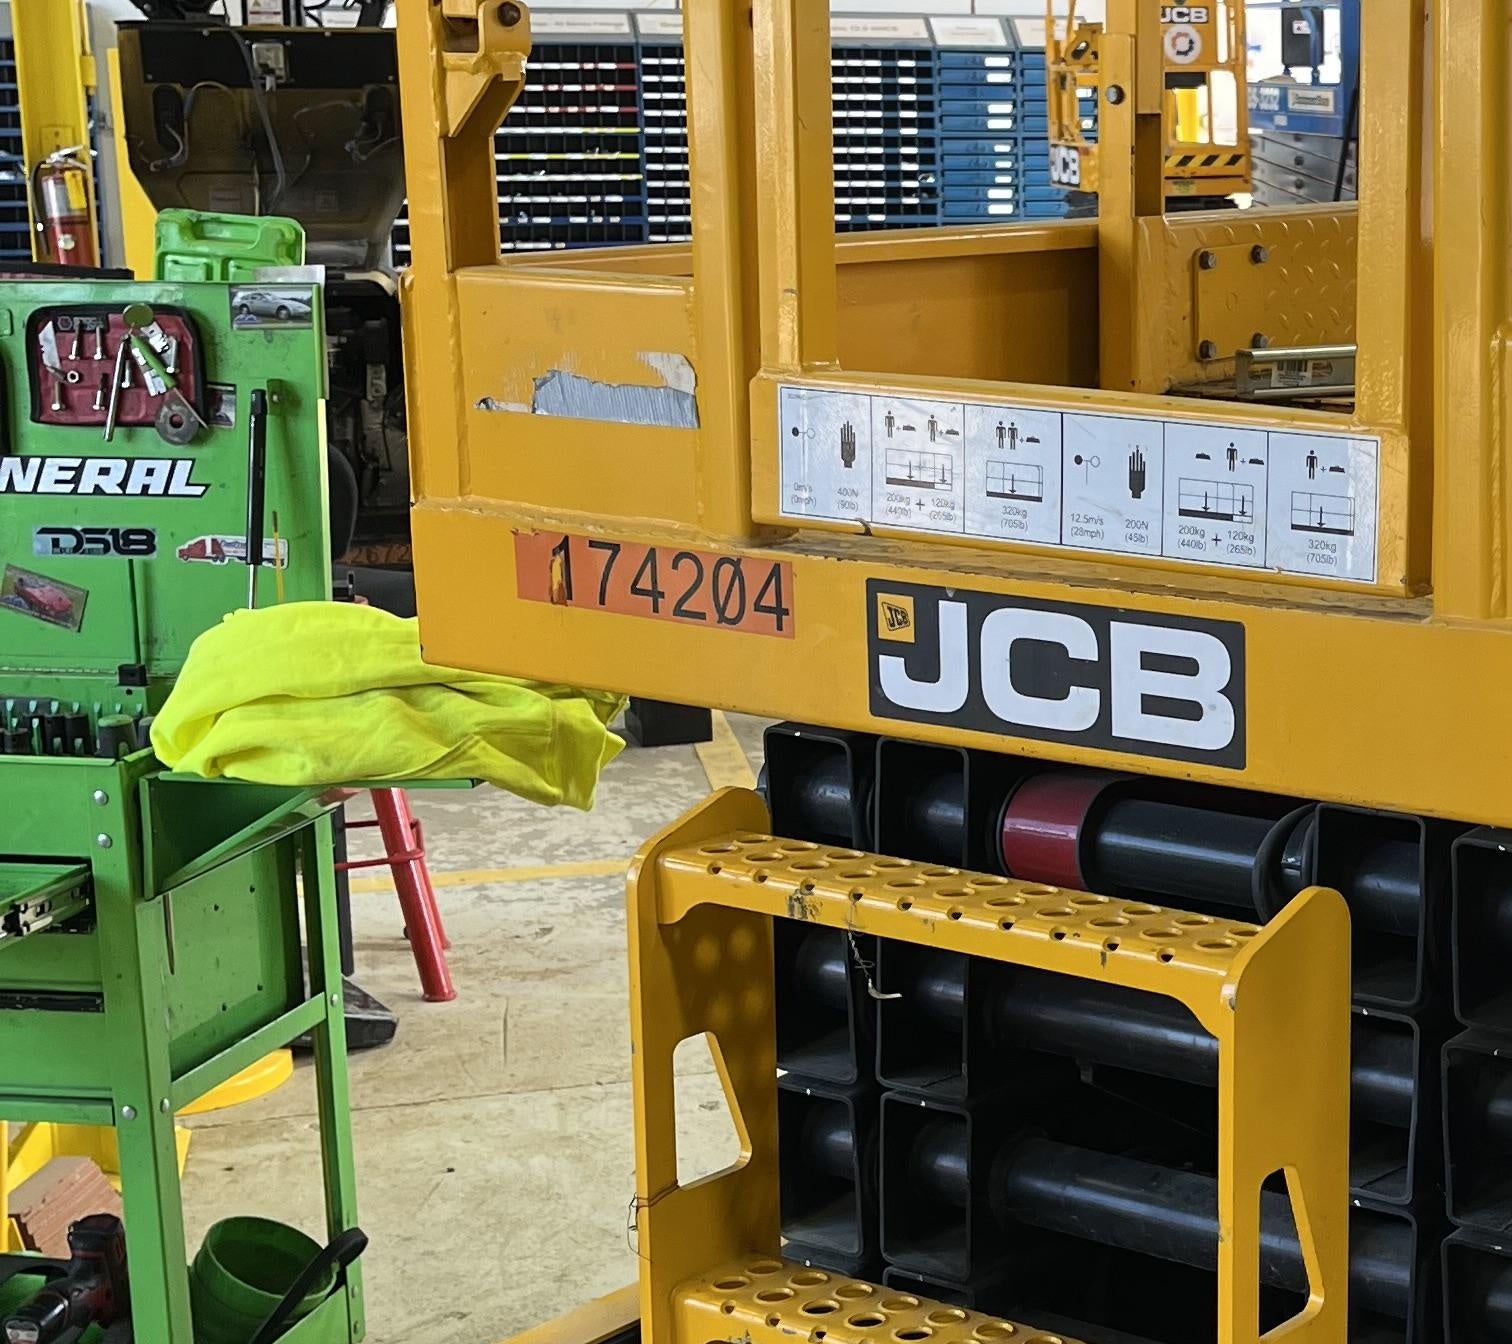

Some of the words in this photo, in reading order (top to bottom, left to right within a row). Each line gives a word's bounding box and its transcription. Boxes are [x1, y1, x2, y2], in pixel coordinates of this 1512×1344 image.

[1161, 7, 1208, 23] JCB
[36, 527, 157, 556] DS18
[1178, 525, 1206, 539] 200kg
[1227, 529, 1255, 544] 120kg
[1177, 537, 1207, 552] (440lb)
[1308, 539, 1337, 554] 320kg
[1306, 552, 1338, 566] (705lb)
[551, 534, 790, 632] 174204
[887, 605, 909, 628] JCB
[878, 599, 1237, 751] JCB
